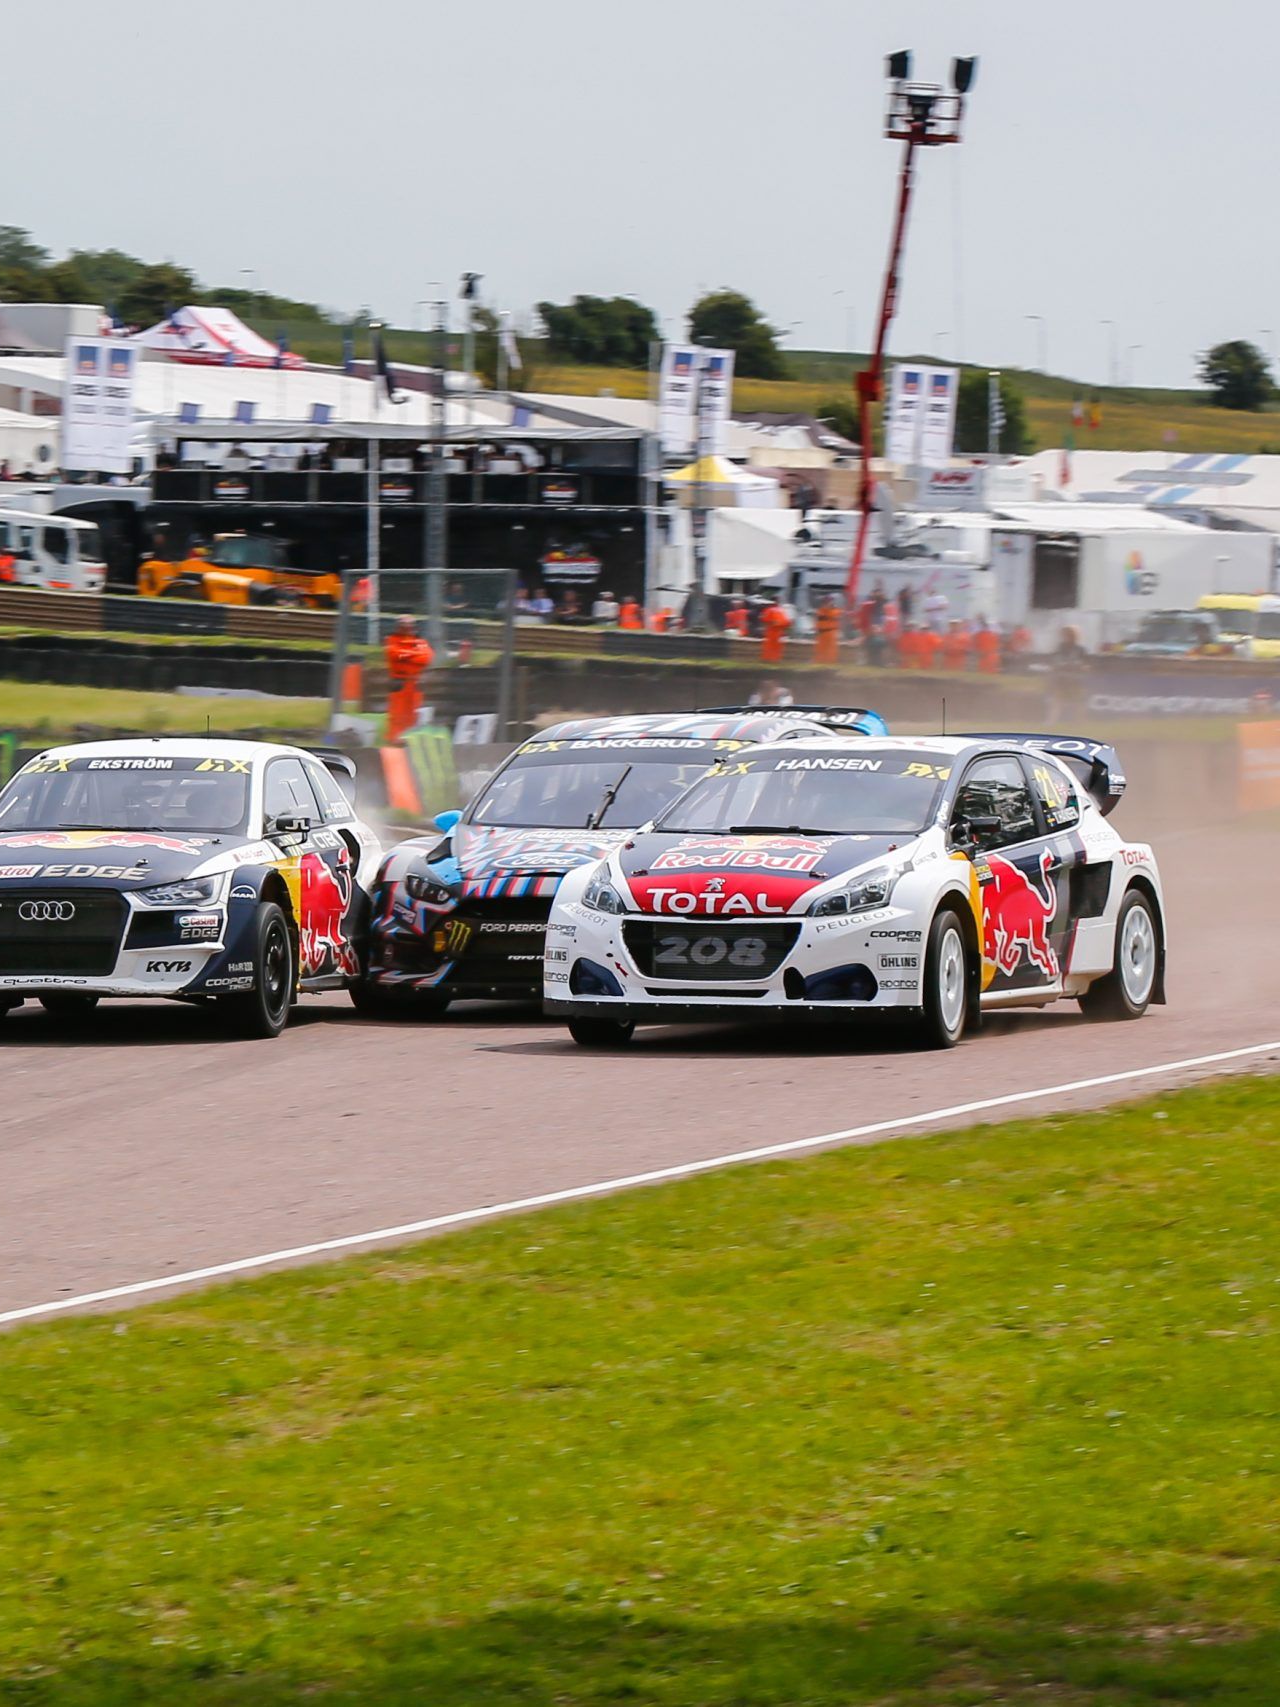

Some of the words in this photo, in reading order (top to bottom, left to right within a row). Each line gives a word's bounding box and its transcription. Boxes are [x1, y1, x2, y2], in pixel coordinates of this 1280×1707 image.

[570, 739, 706, 750] BAKKERUD
[88, 757, 173, 769] EKSTRÖM
[774, 758, 882, 771] HANSEN
[649, 851, 733, 870] Red
[733, 851, 824, 872] Bull
[39, 864, 153, 882] EDGE
[646, 888, 785, 914] TOTAL
[480, 923, 507, 932] FORD
[816, 910, 896, 934] PEUGEOT
[180, 928, 220, 939] EDGE
[870, 930, 922, 938] COOPER
[655, 936, 767, 966] 208
[146, 961, 192, 973] KYB
[881, 955, 917, 968] ÖHLINS
[4, 977, 87, 985] quattro
[205, 976, 253, 987] COOPER
[879, 979, 918, 988] sparco
